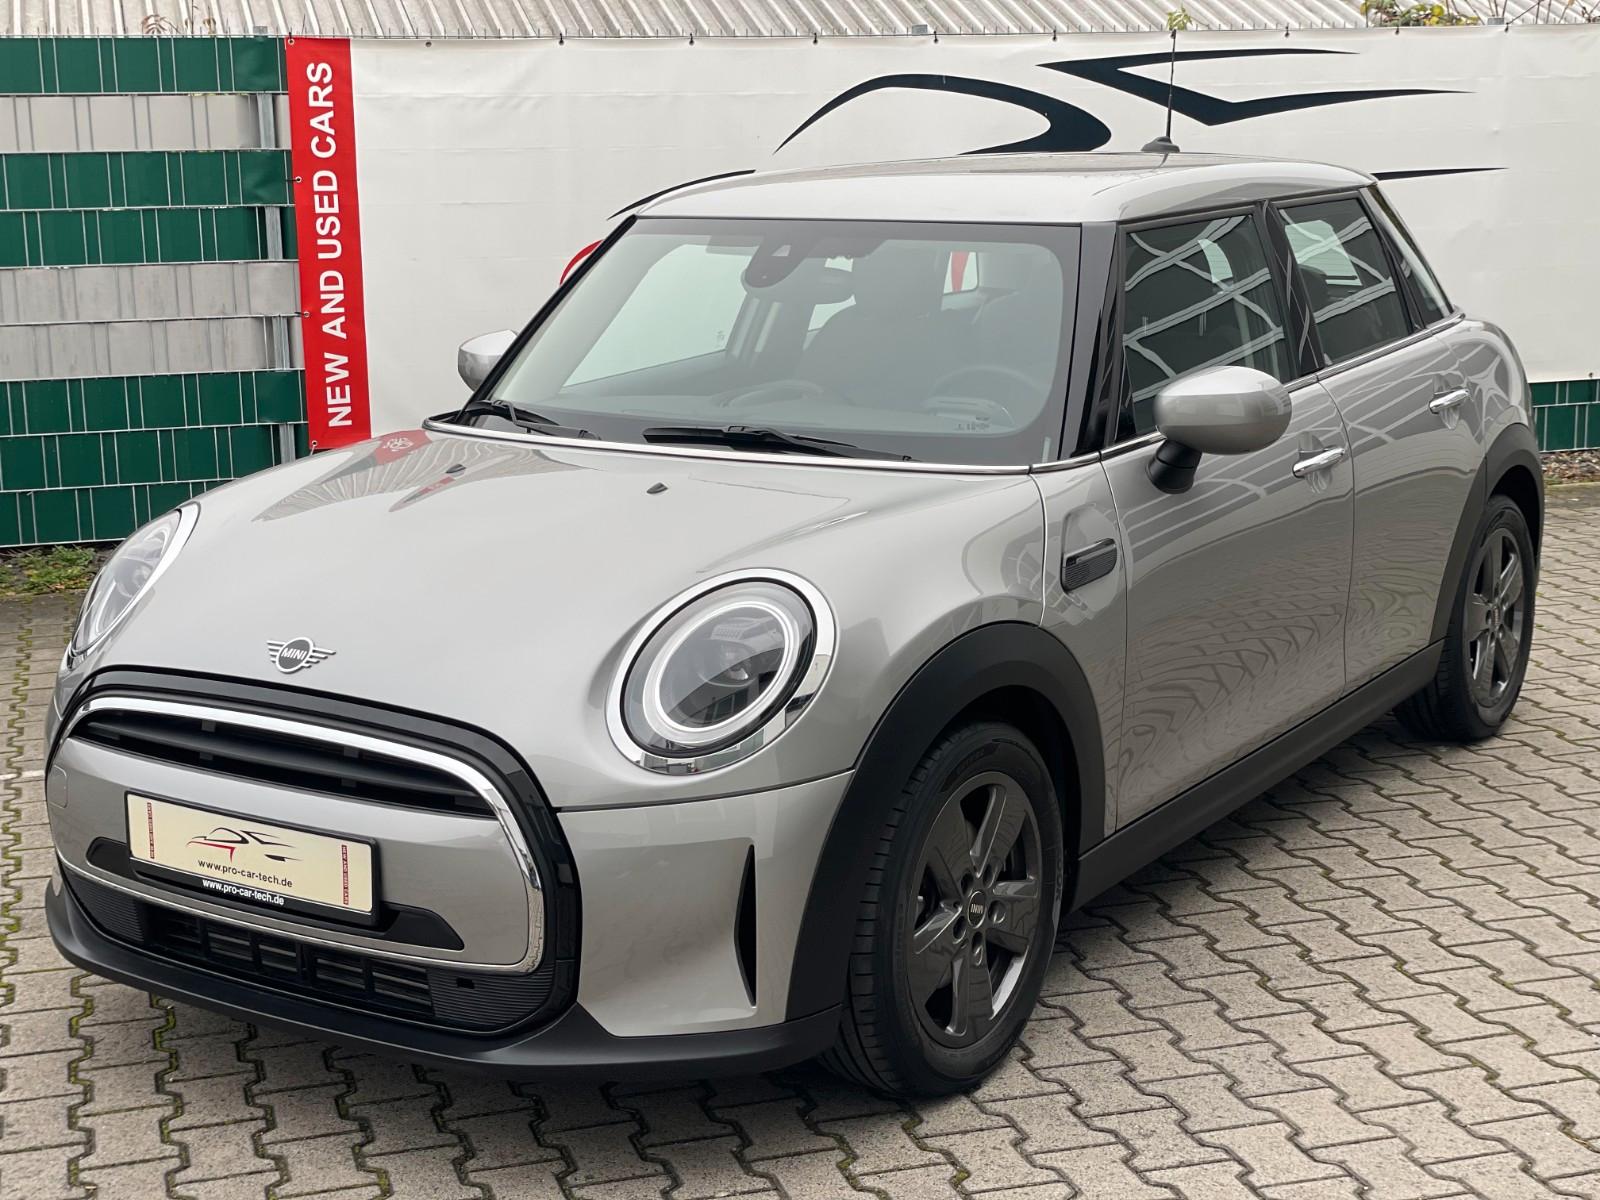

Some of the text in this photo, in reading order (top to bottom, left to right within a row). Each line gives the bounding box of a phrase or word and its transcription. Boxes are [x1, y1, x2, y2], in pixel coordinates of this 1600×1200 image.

[306, 61, 352, 427] NEW AND USED CARS
[281, 647, 307, 660] MINI
[197, 859, 293, 888] www.pro-car-tech.de
[202, 879, 285, 906] www.pro-car-tech.de
